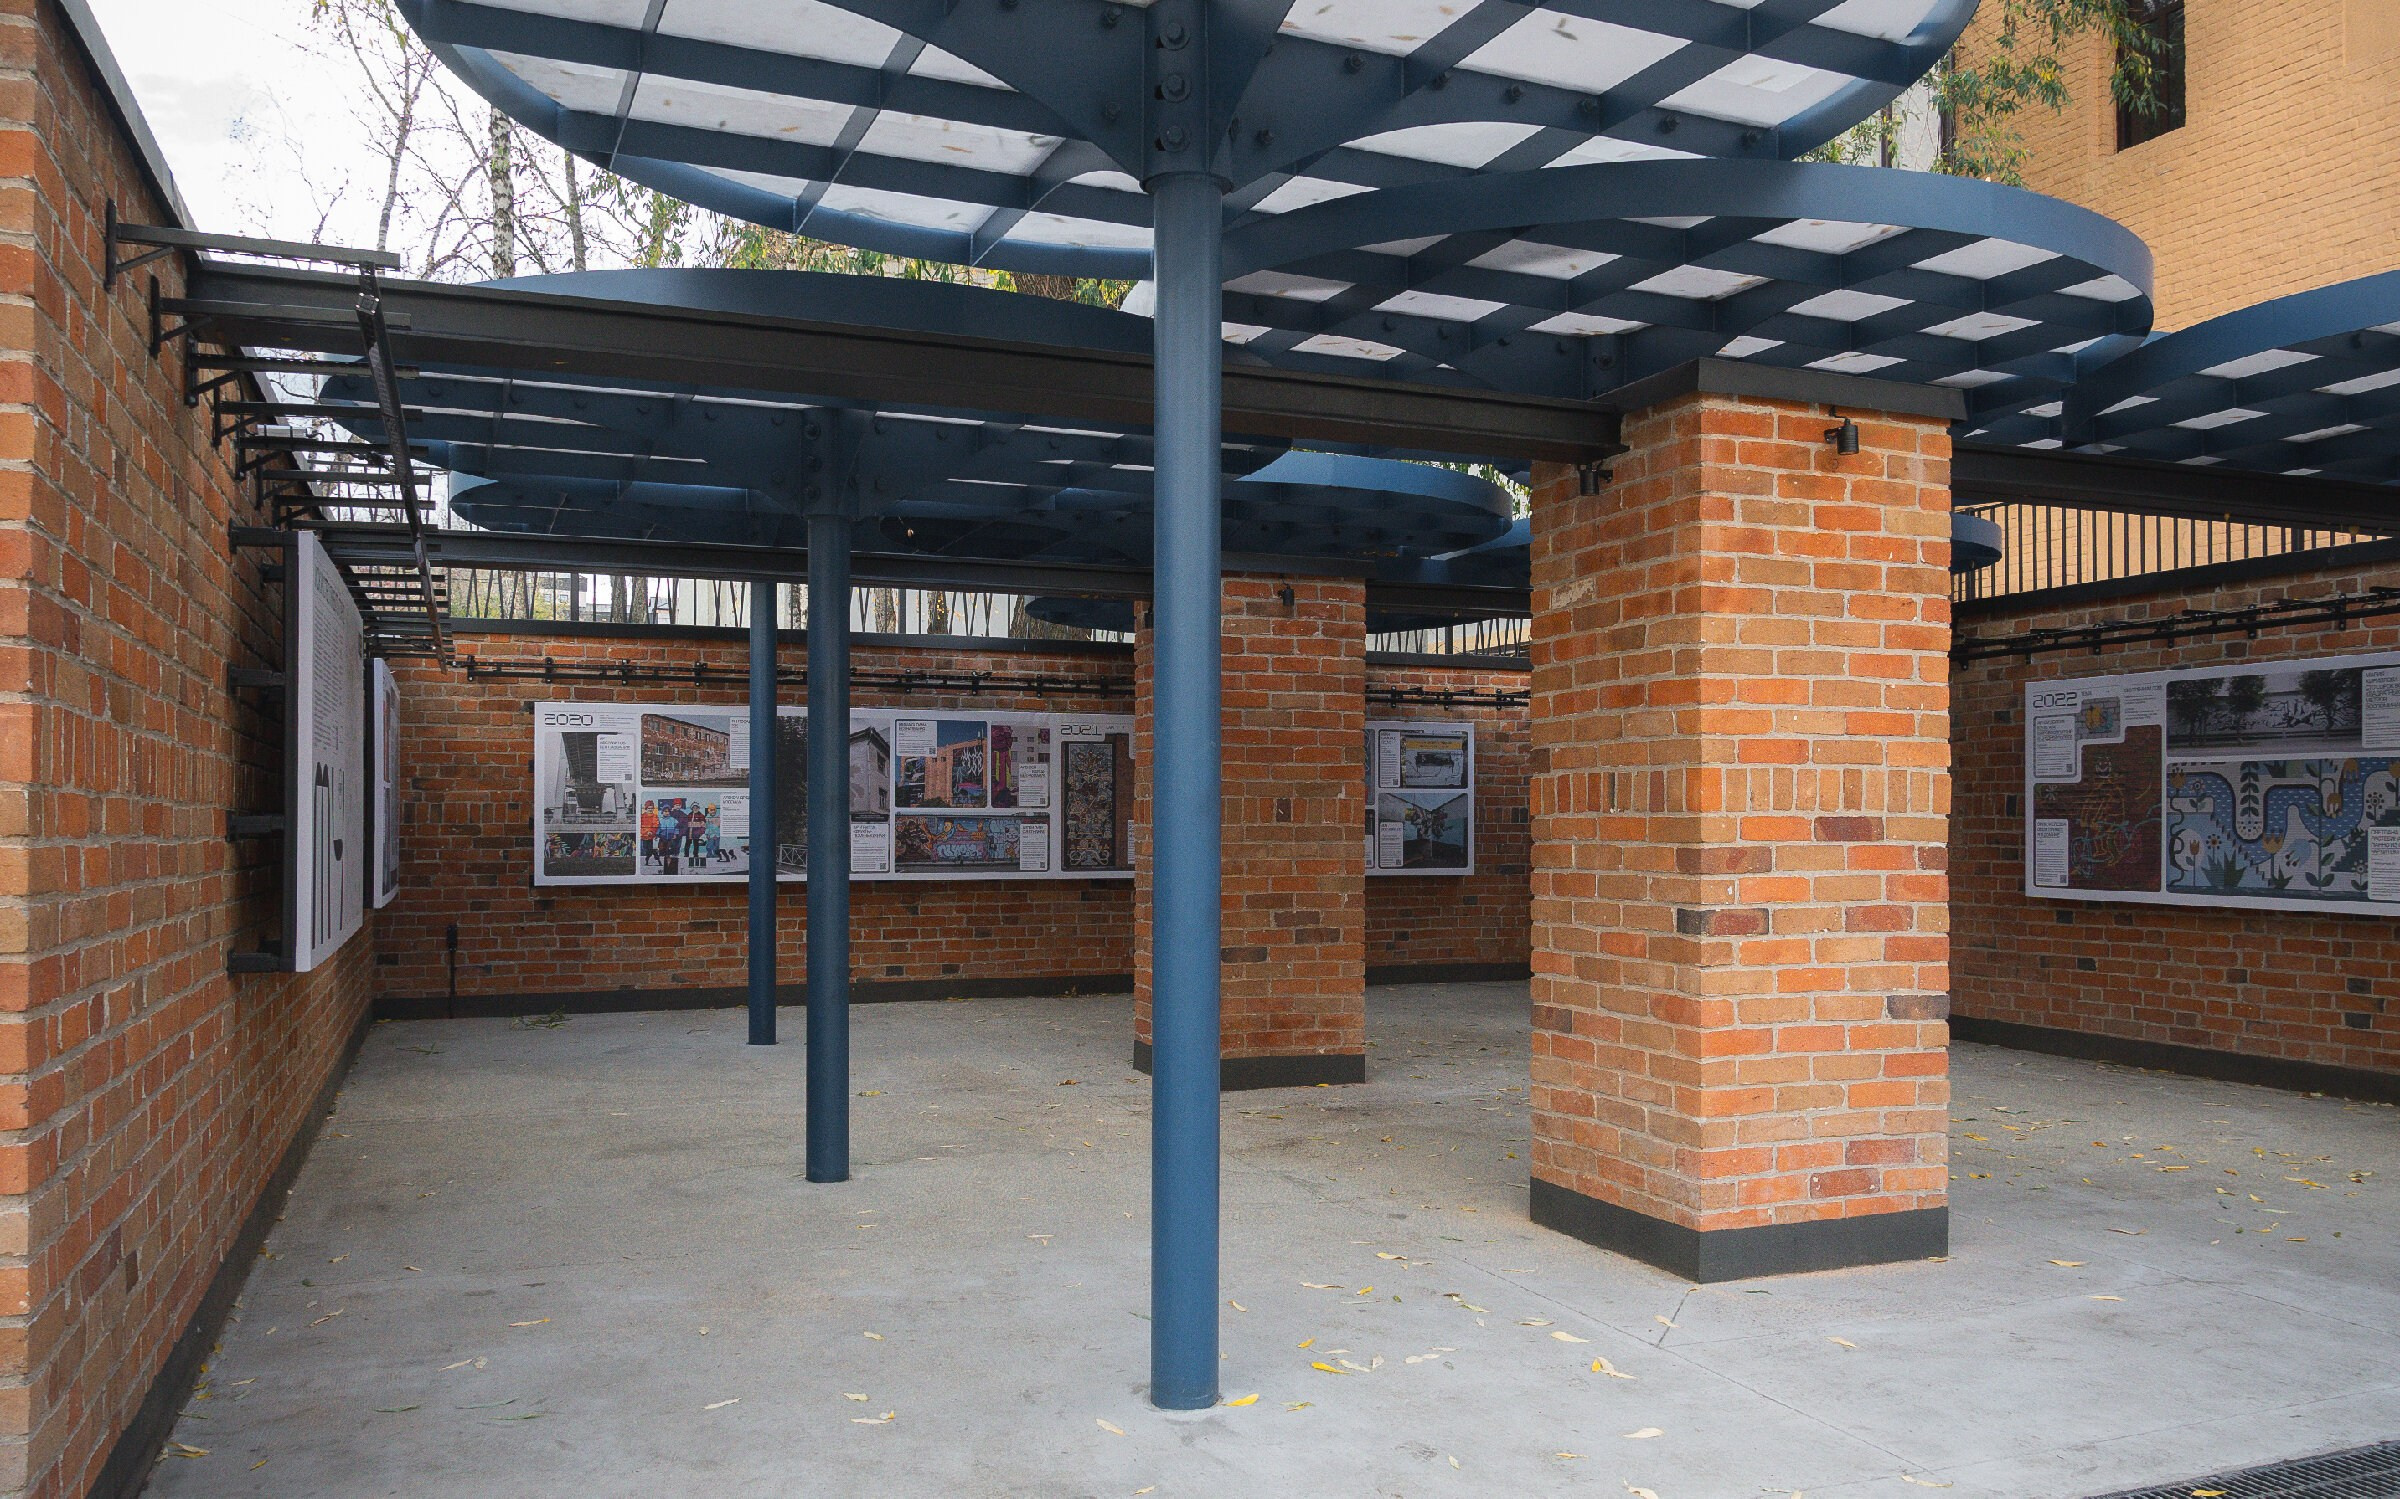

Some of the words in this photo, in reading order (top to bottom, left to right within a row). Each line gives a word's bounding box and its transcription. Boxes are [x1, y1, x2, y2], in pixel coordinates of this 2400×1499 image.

[2033, 691, 2078, 709] 2022
[544, 713, 593, 727] 2020
[1060, 724, 1102, 736] 2021
